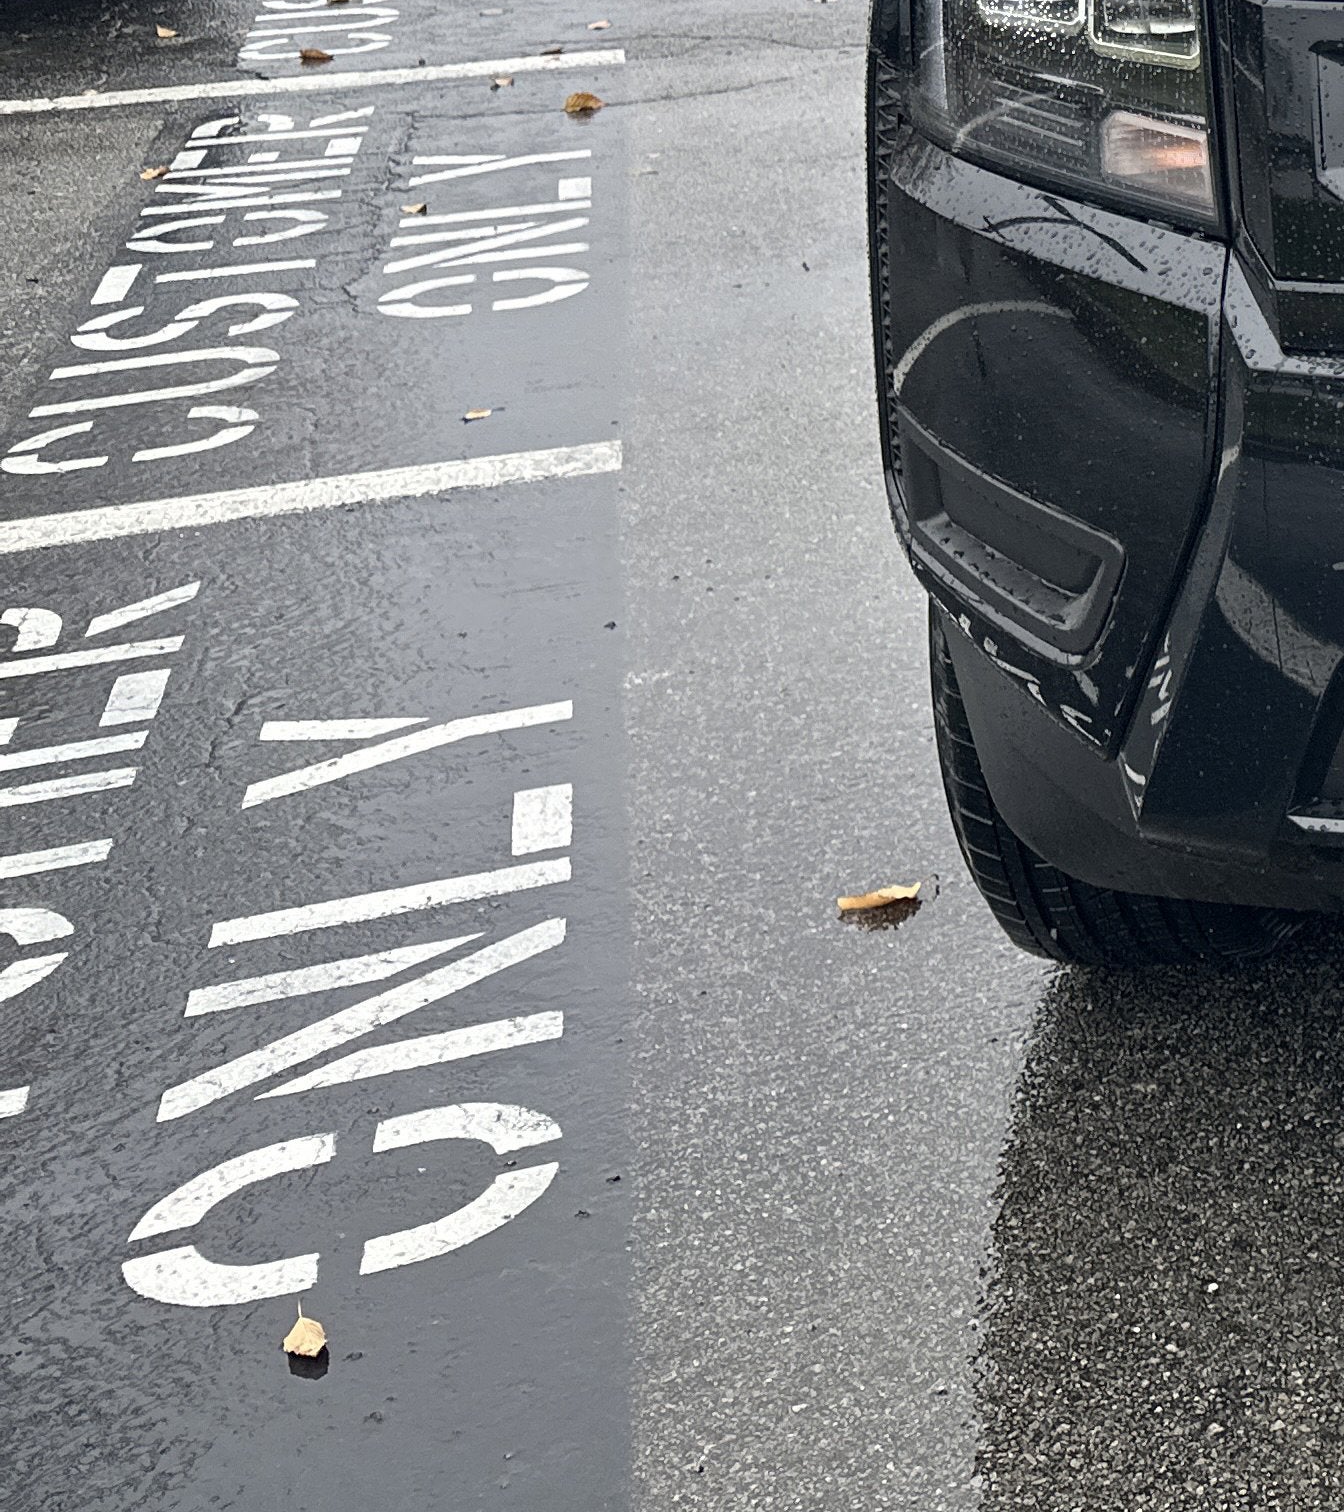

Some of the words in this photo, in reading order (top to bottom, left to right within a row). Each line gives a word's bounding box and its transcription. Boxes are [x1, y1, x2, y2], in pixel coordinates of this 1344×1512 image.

[1, 105, 375, 476] CUSTOMER
[377, 149, 593, 319] ONLY
[121, 699, 574, 1308] ONLY
